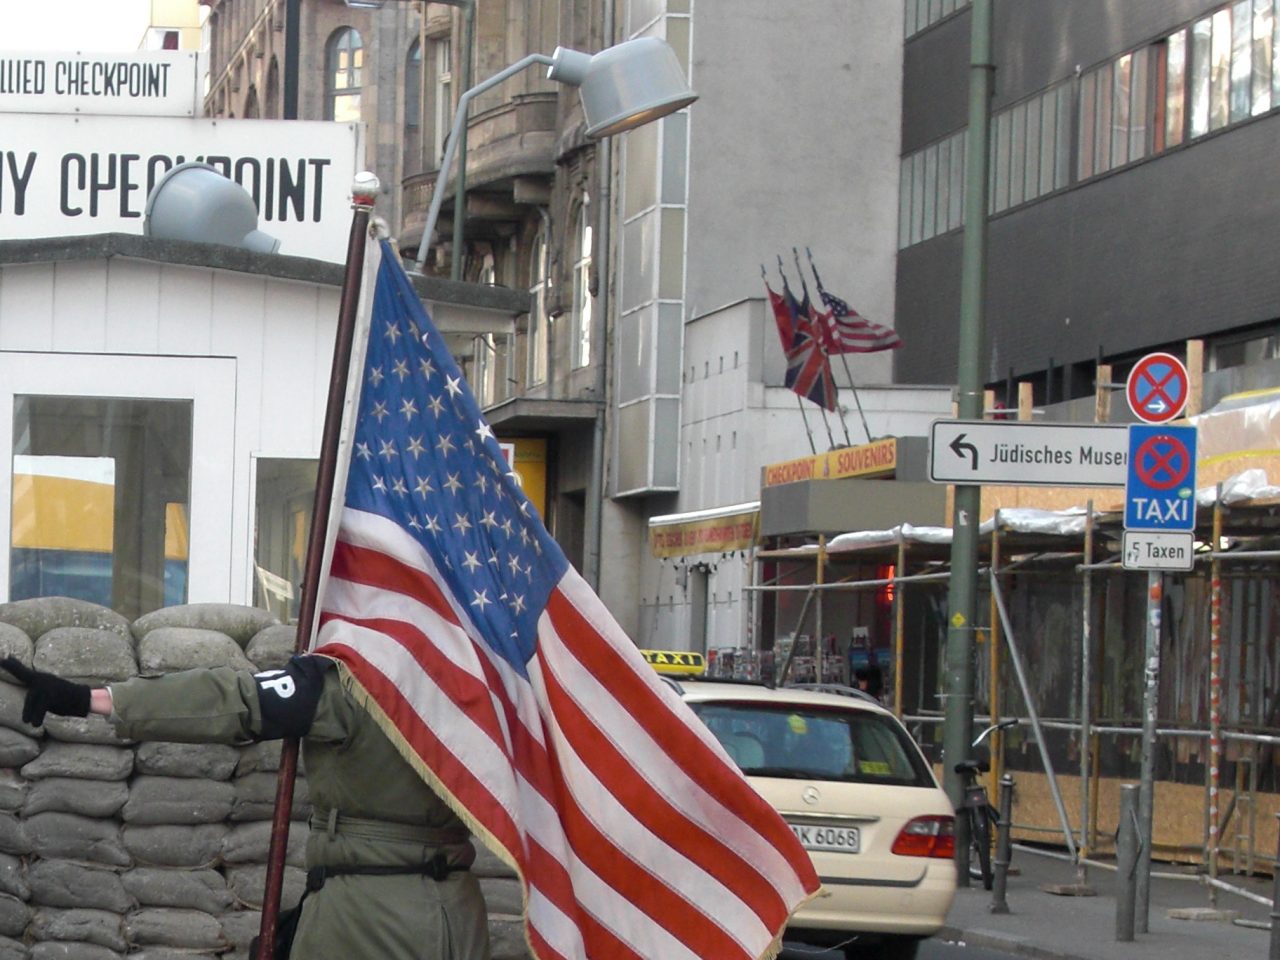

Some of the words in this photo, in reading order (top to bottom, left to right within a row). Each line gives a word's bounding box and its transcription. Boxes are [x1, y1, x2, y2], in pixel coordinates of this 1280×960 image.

[55, 61, 172, 98] CHECKPOINT
[59, 153, 332, 223] CHECOINT
[767, 459, 816, 486] CHECKPOINT
[837, 442, 894, 474] SOUVENIRS
[990, 443, 1072, 464] Jüdisches
[1132, 498, 1188, 521] TAXI
[1146, 542, 1184, 559] Taxen
[640, 651, 695, 666] TAXI
[815, 829, 856, 847] 6068
